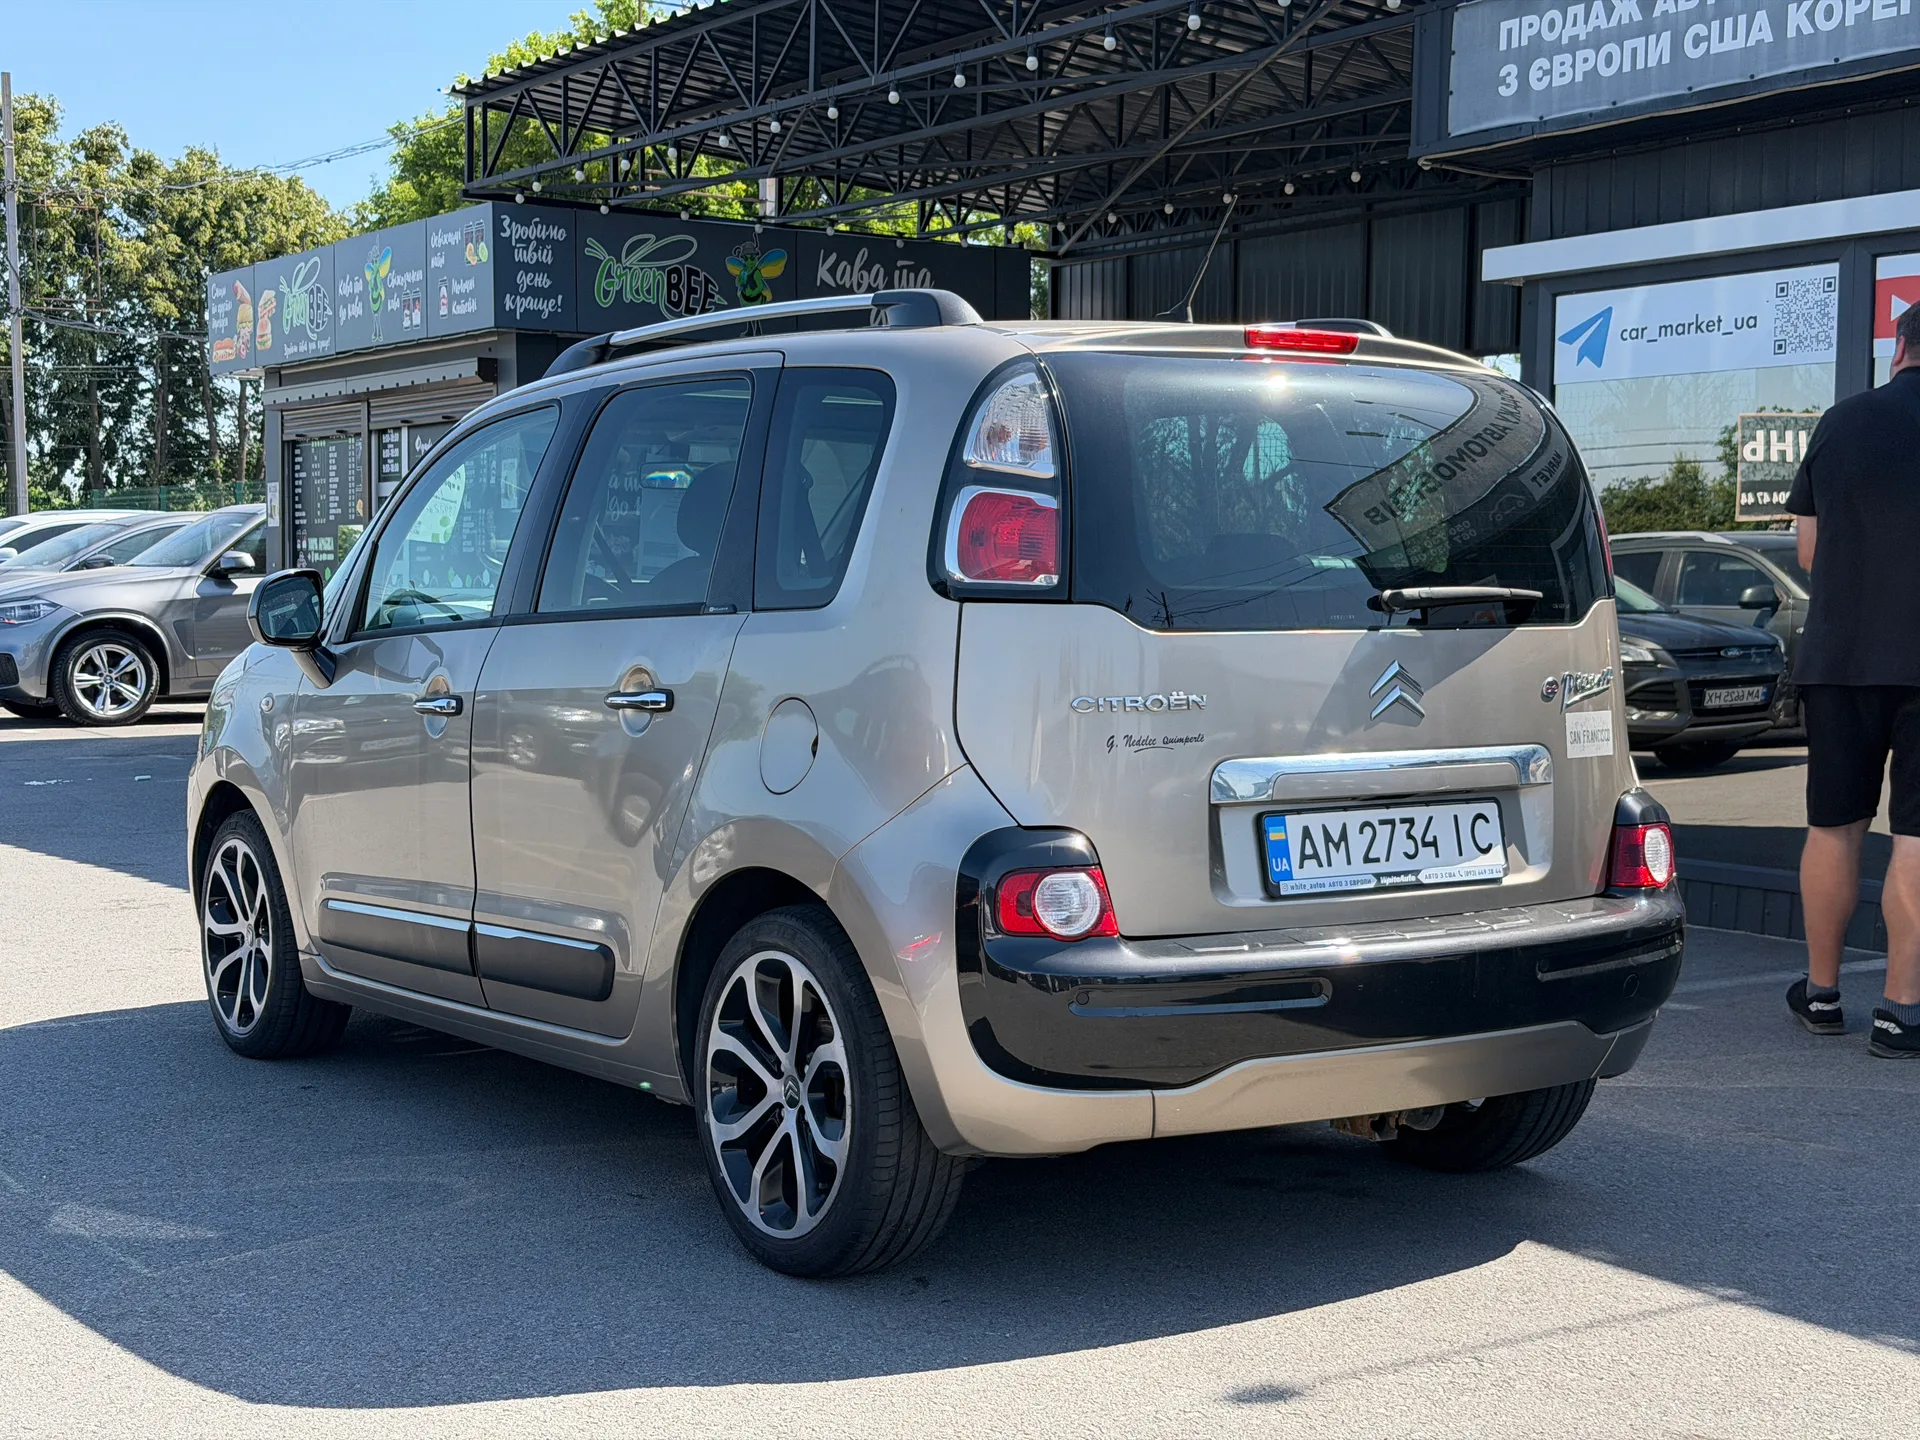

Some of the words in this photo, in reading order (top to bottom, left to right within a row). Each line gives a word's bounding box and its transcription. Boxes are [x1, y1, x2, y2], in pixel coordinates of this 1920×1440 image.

[1499, 0, 1643, 51] ПРОДАЖ
[1497, 63, 1519, 97] З
[1529, 29, 1671, 91] ЄВРОПИ
[1683, 9, 1774, 60] США
[500, 214, 567, 242] Зробимо
[514, 240, 553, 265] твій
[516, 267, 551, 293] день
[816, 247, 889, 294] Кава
[504, 292, 563, 323] краще!
[1620, 313, 1758, 344] car_market_ua
[1071, 691, 1207, 713] CITROËN
[1569, 729, 1581, 745] SAN
[1298, 821, 1352, 870] AM
[1359, 815, 1440, 864] 2734
[1455, 810, 1494, 859] IC
[1273, 856, 1290, 873] UA
